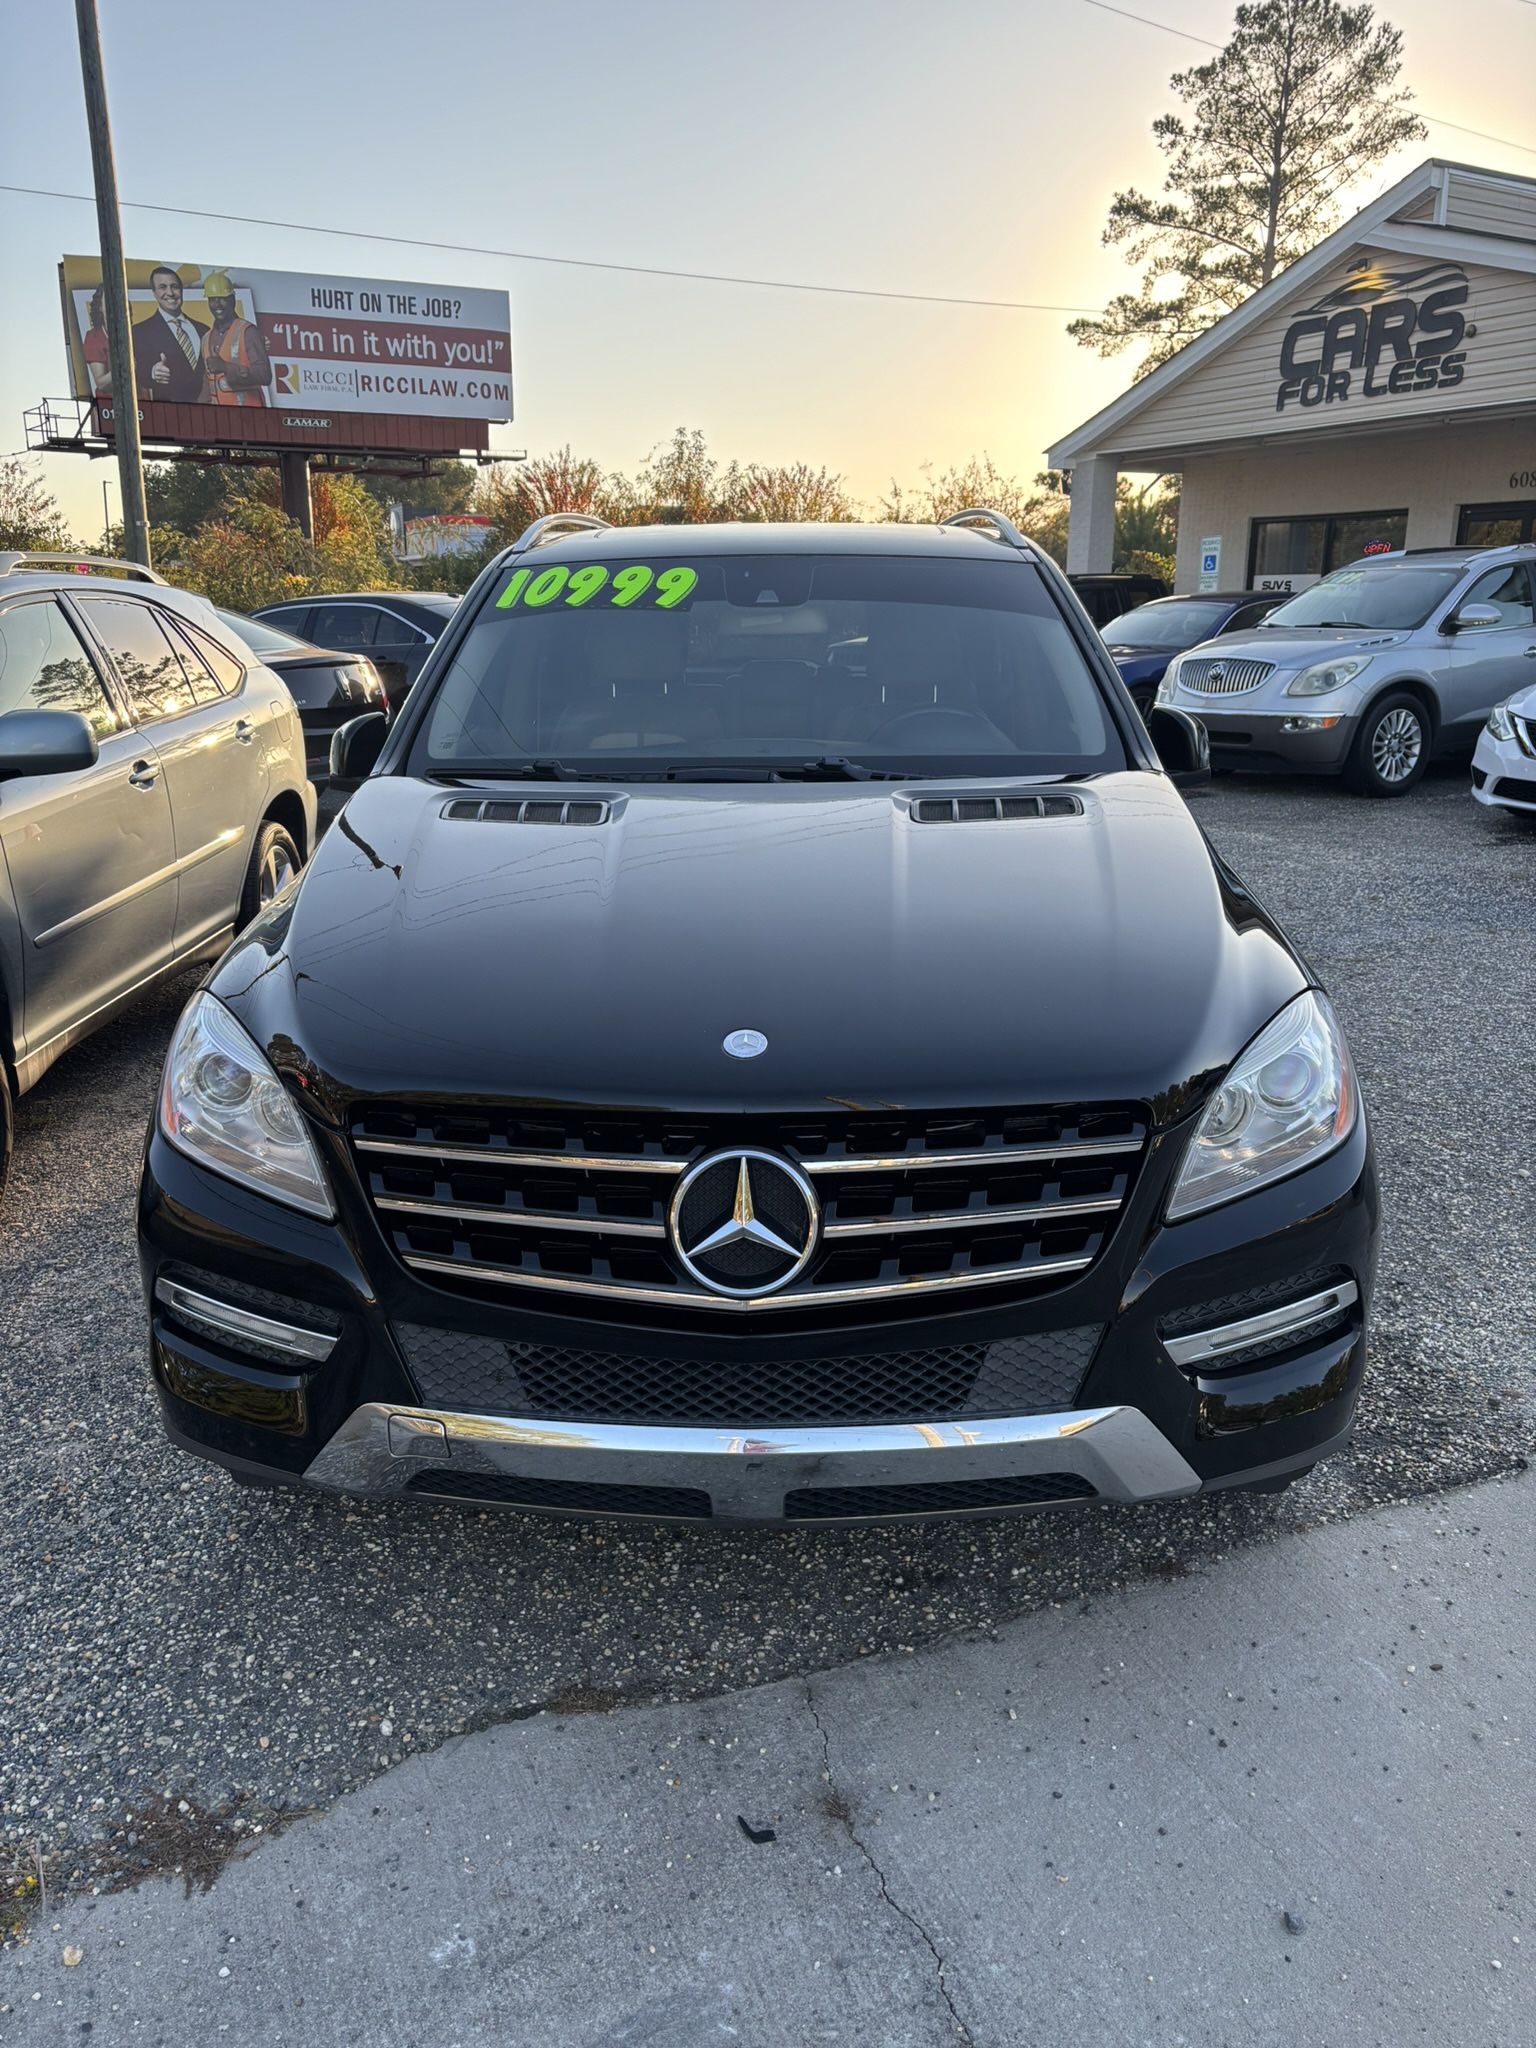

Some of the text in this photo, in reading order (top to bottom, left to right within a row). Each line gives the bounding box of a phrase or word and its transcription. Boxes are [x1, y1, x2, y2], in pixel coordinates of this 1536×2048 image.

[311, 288, 462, 319] HURT ON THE JOB?
[332, 327, 355, 354] in
[363, 329, 380, 356] it
[385, 333, 437, 360] with
[1280, 285, 1469, 381] CARS
[303, 369, 353, 385] RICCI
[361, 374, 509, 401] RICCILAW.COM
[1276, 352, 1467, 412] FOR LESS
[287, 418, 328, 428] LAMAR
[495, 565, 698, 609] 10999
